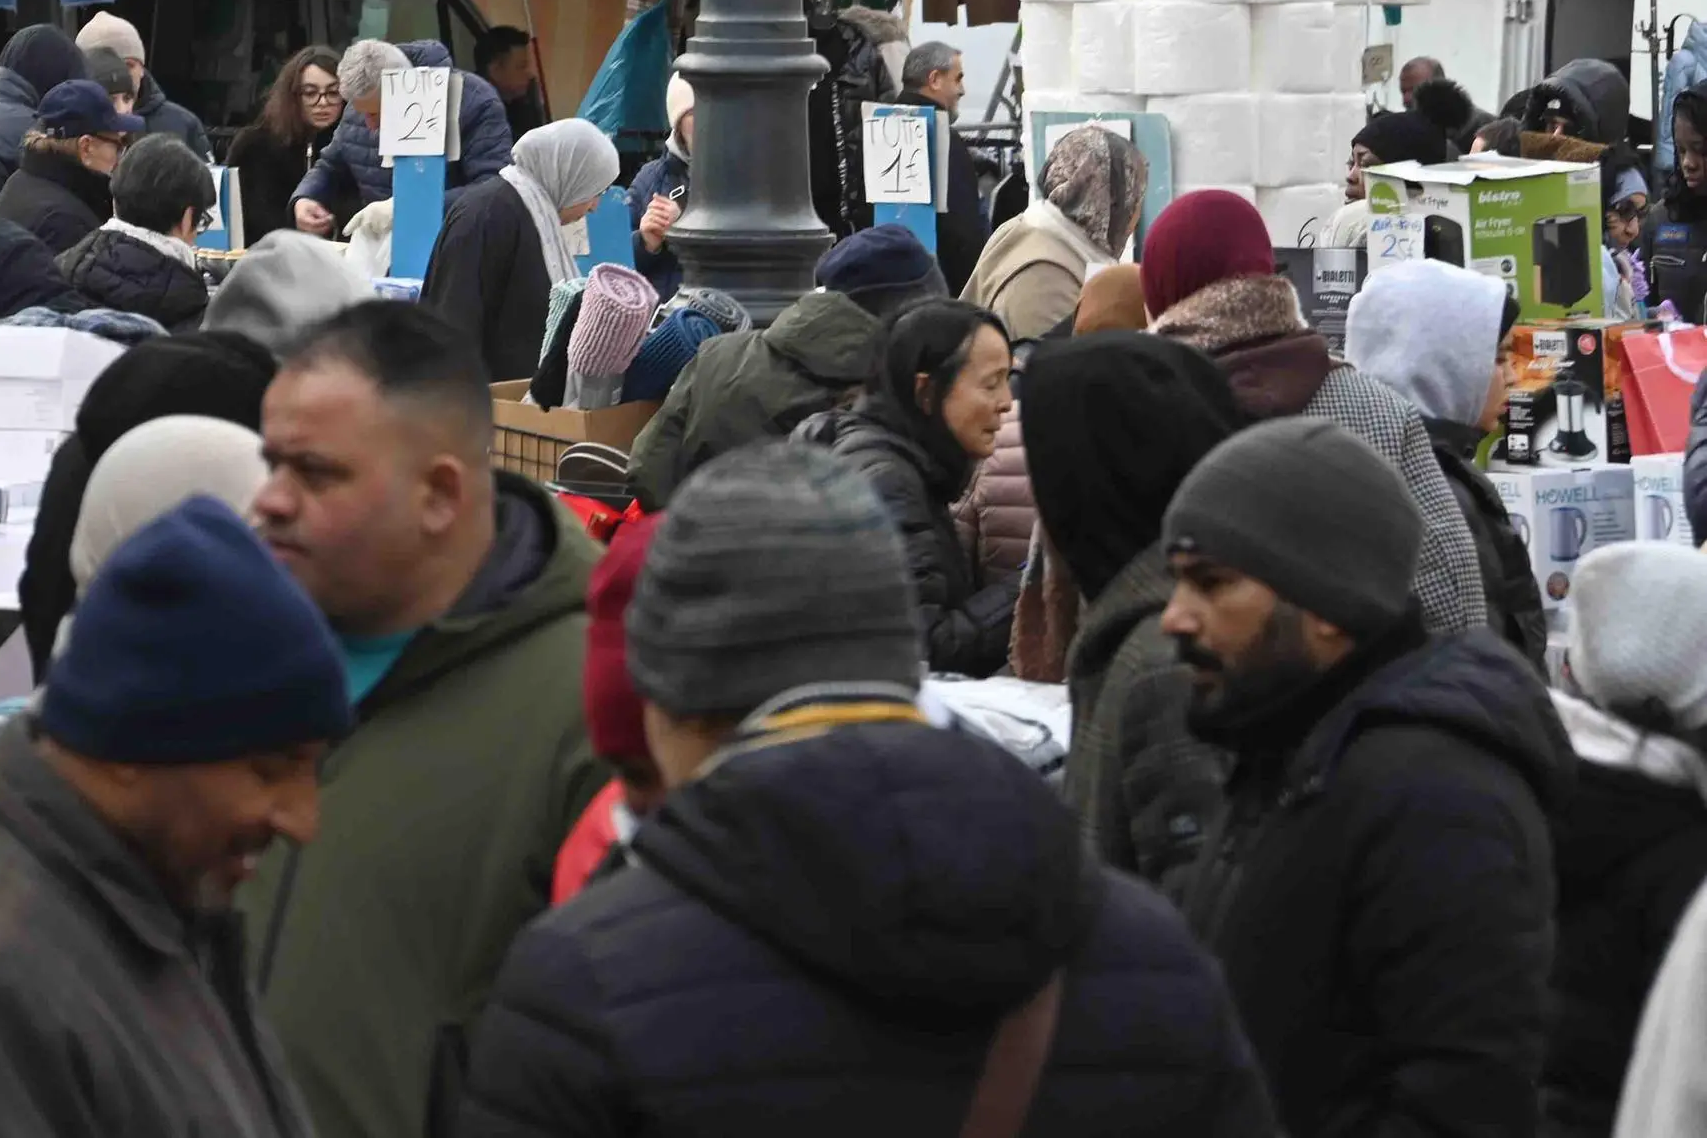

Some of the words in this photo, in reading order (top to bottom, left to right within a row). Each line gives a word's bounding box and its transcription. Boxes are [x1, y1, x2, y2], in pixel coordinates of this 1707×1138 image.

[383, 70, 443, 96] TUTTO
[865, 117, 923, 148] TUTTO
[1536, 486, 1601, 505] HOWELL
